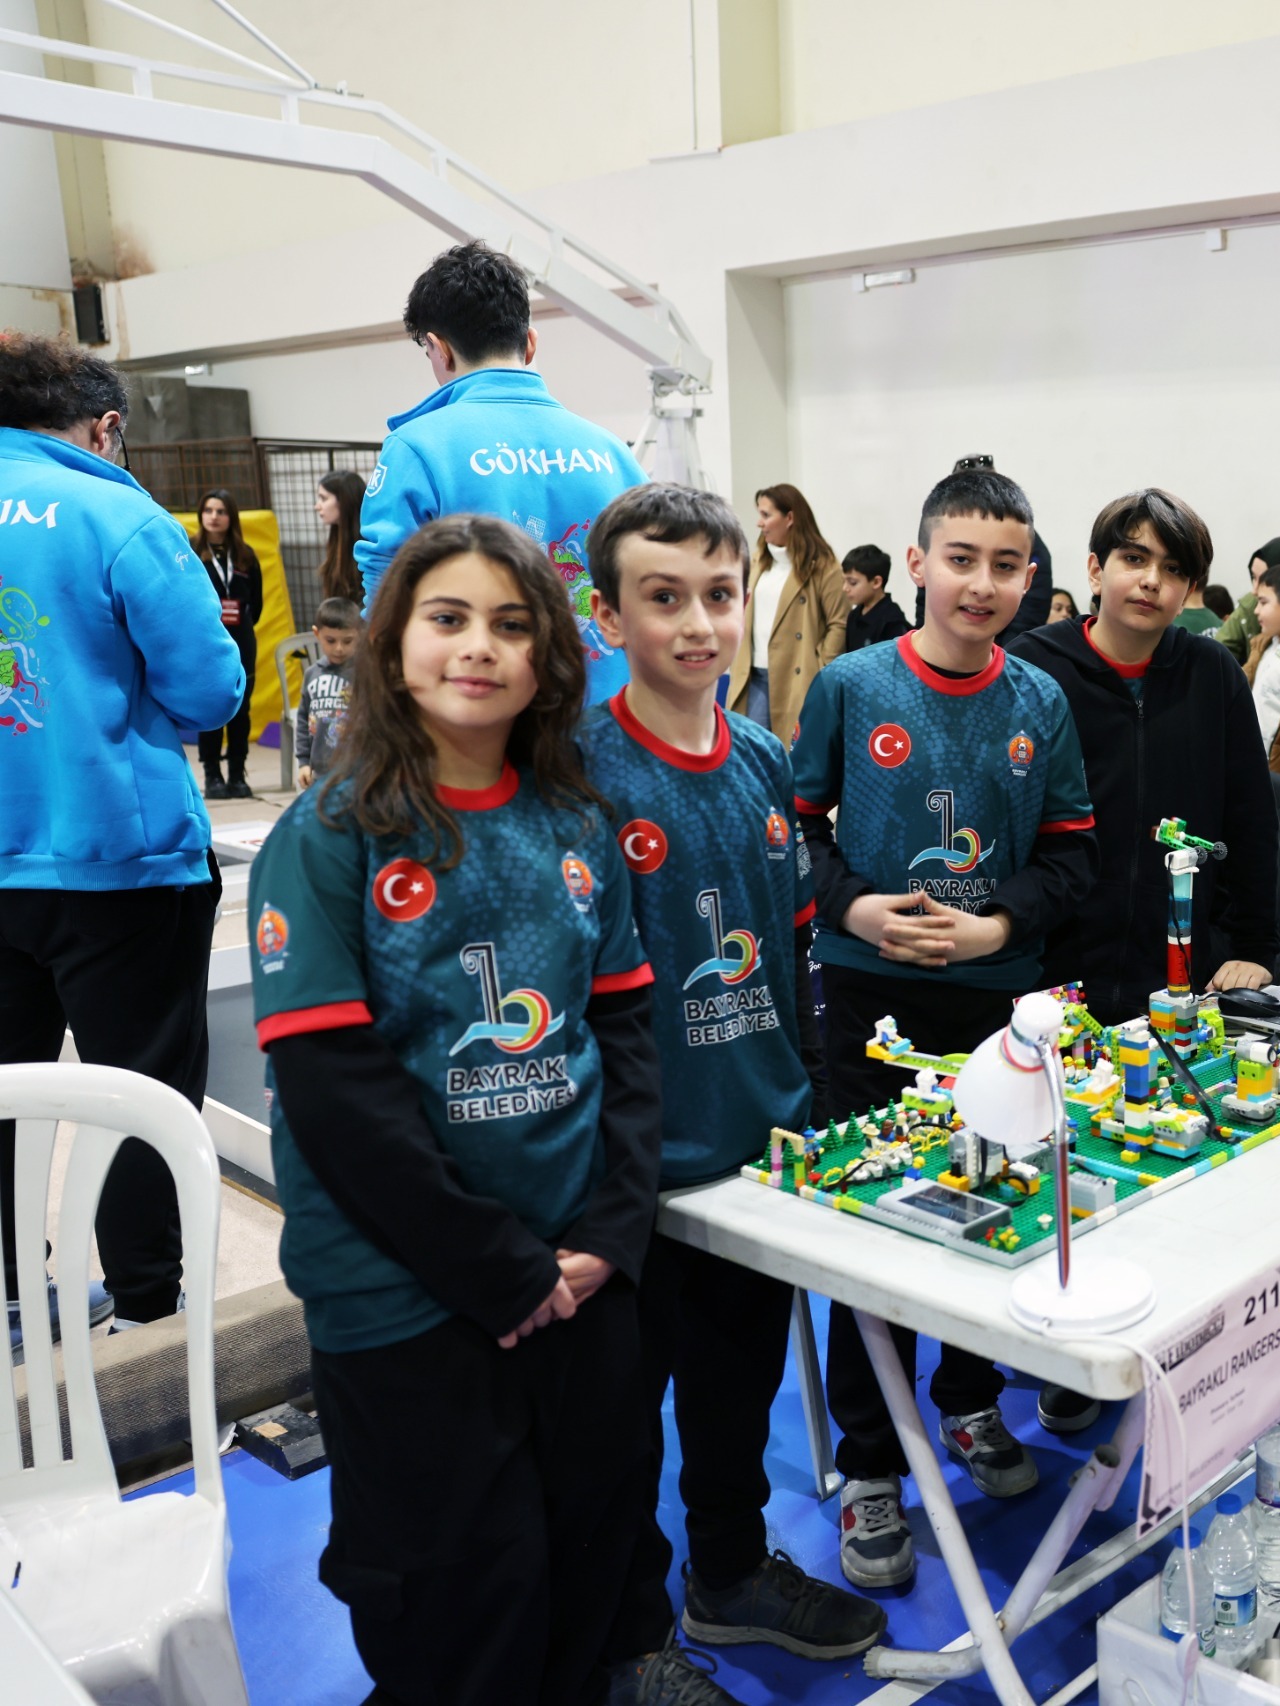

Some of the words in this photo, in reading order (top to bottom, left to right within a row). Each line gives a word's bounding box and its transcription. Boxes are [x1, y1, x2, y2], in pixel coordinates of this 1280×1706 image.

[470, 442, 614, 475] GÖKHAN
[686, 1008, 781, 1047] BELEDİYES
[446, 1054, 568, 1095] BAYRAK
[446, 1081, 578, 1124] BELEDİYES
